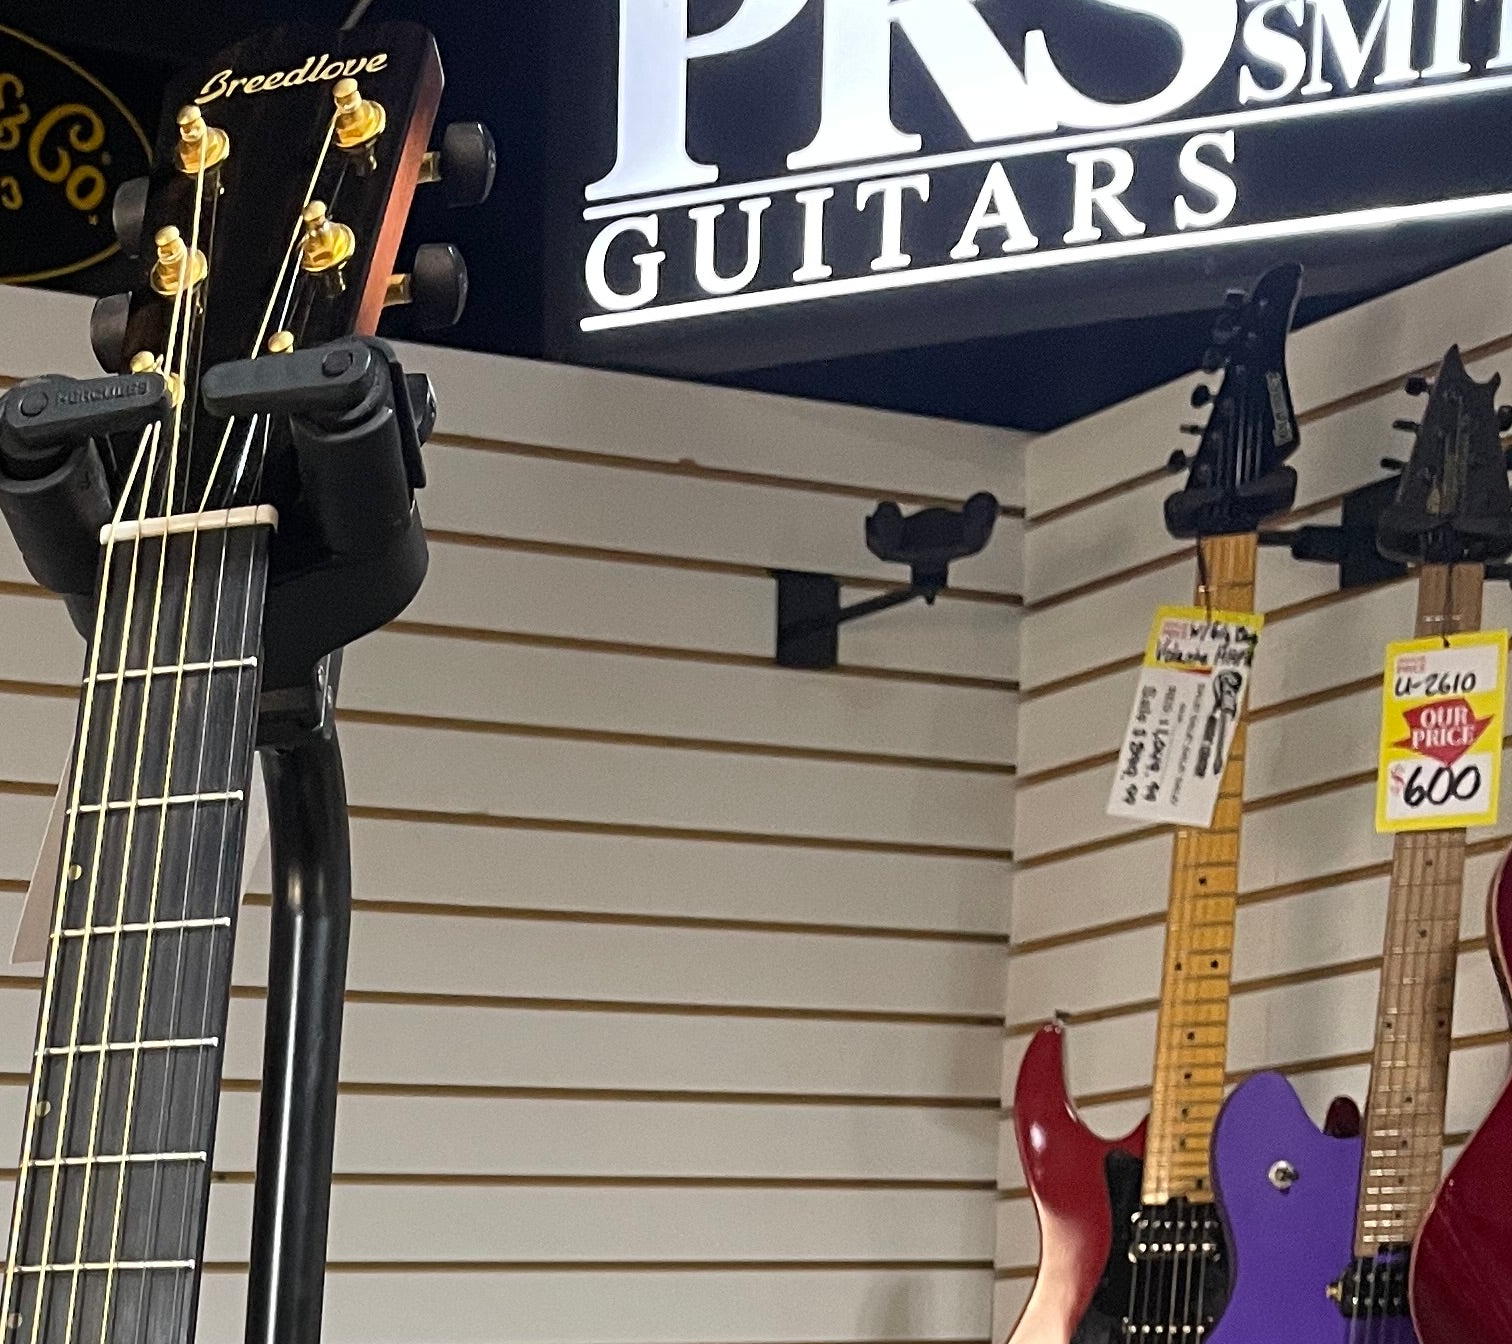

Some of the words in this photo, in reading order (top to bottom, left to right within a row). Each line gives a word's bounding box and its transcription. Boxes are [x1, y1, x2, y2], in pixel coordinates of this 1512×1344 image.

[194, 53, 388, 105] Breedlove
[584, 131, 1238, 311] GUITARS
[1411, 725, 1476, 750] PRICE
[1420, 705, 1469, 731] OUR
